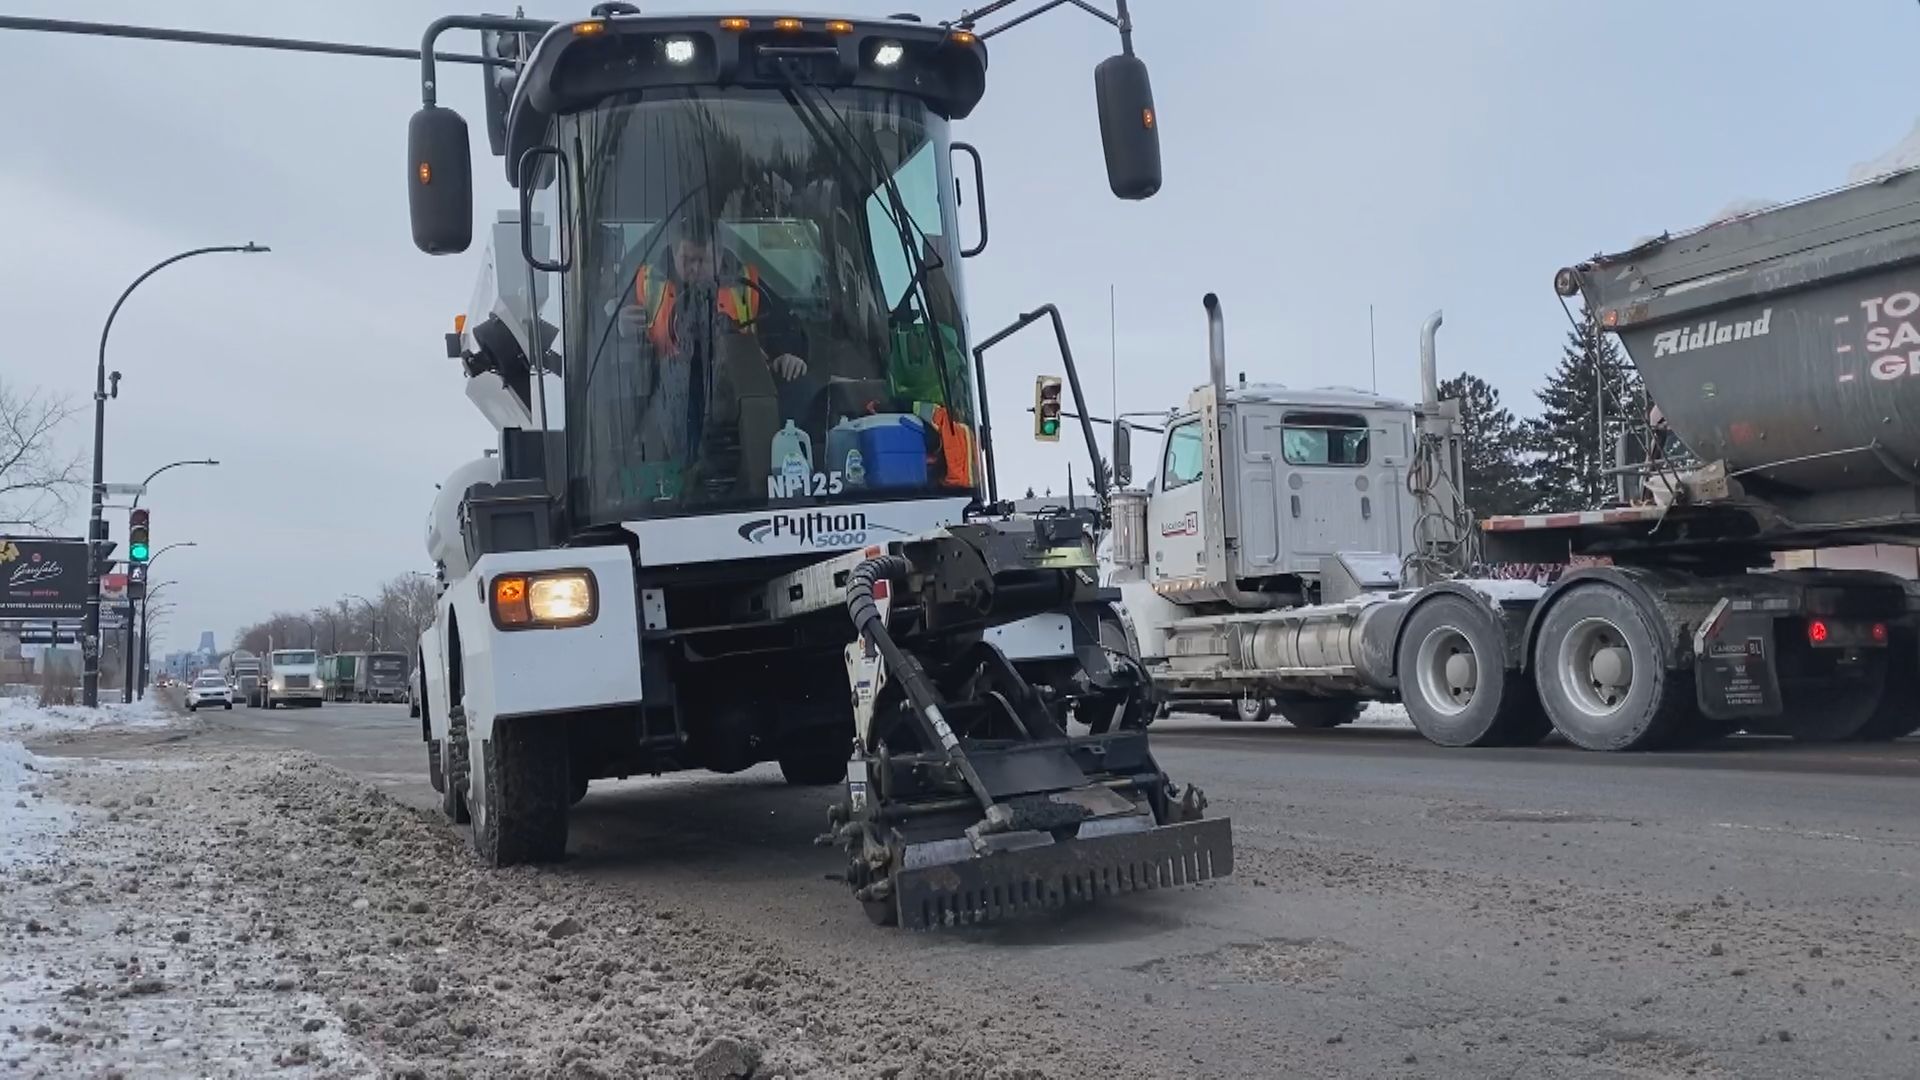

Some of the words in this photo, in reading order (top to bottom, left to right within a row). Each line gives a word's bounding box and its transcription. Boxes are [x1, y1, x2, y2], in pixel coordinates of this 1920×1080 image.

[1653, 308, 1772, 358] Midland
[767, 471, 843, 498] NP125
[773, 513, 866, 546] Python
[816, 531, 866, 548] 5000
